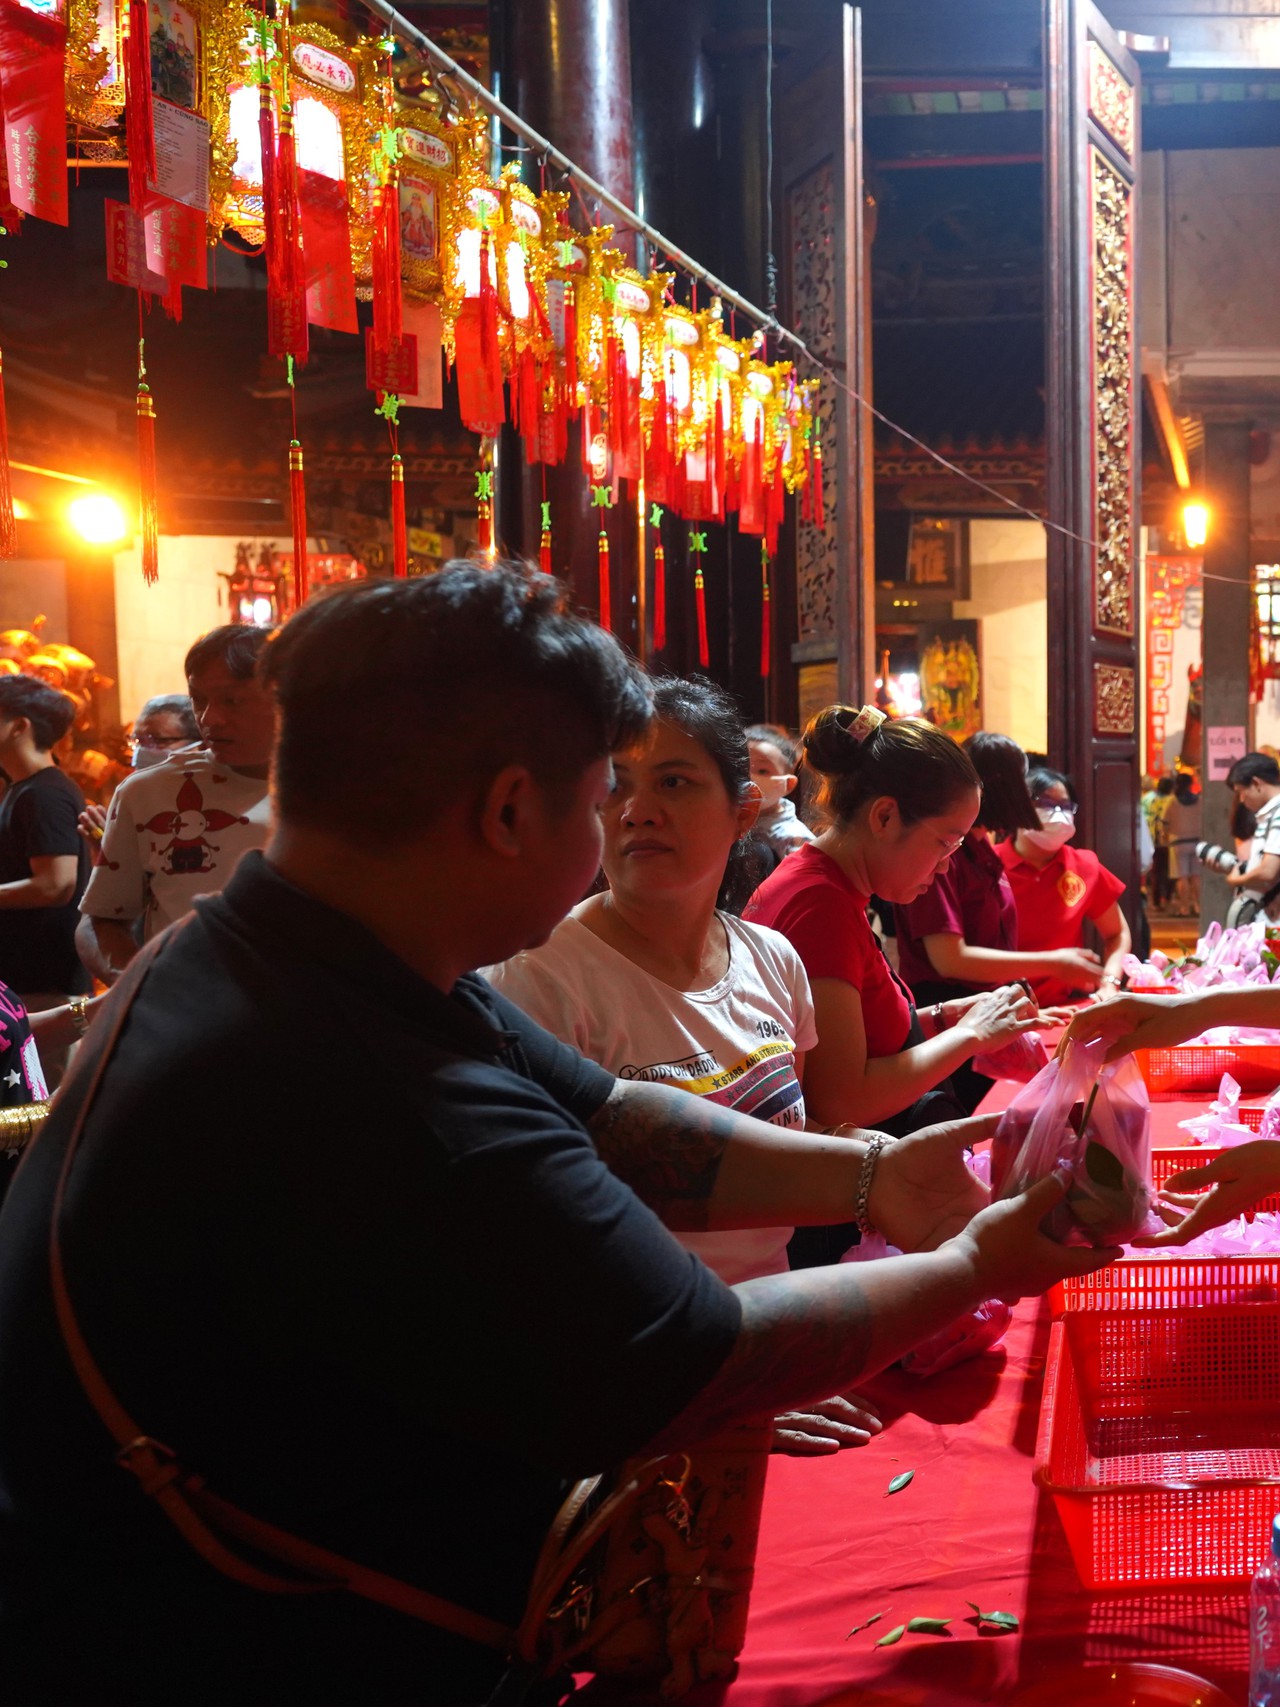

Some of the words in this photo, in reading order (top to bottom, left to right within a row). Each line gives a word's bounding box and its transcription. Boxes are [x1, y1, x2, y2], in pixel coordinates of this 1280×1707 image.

[685, 1056, 720, 1077] DADDY
[721, 1065, 745, 1085] STARS
[745, 1054, 761, 1070] AND
[760, 1046, 784, 1060] STRIPES
